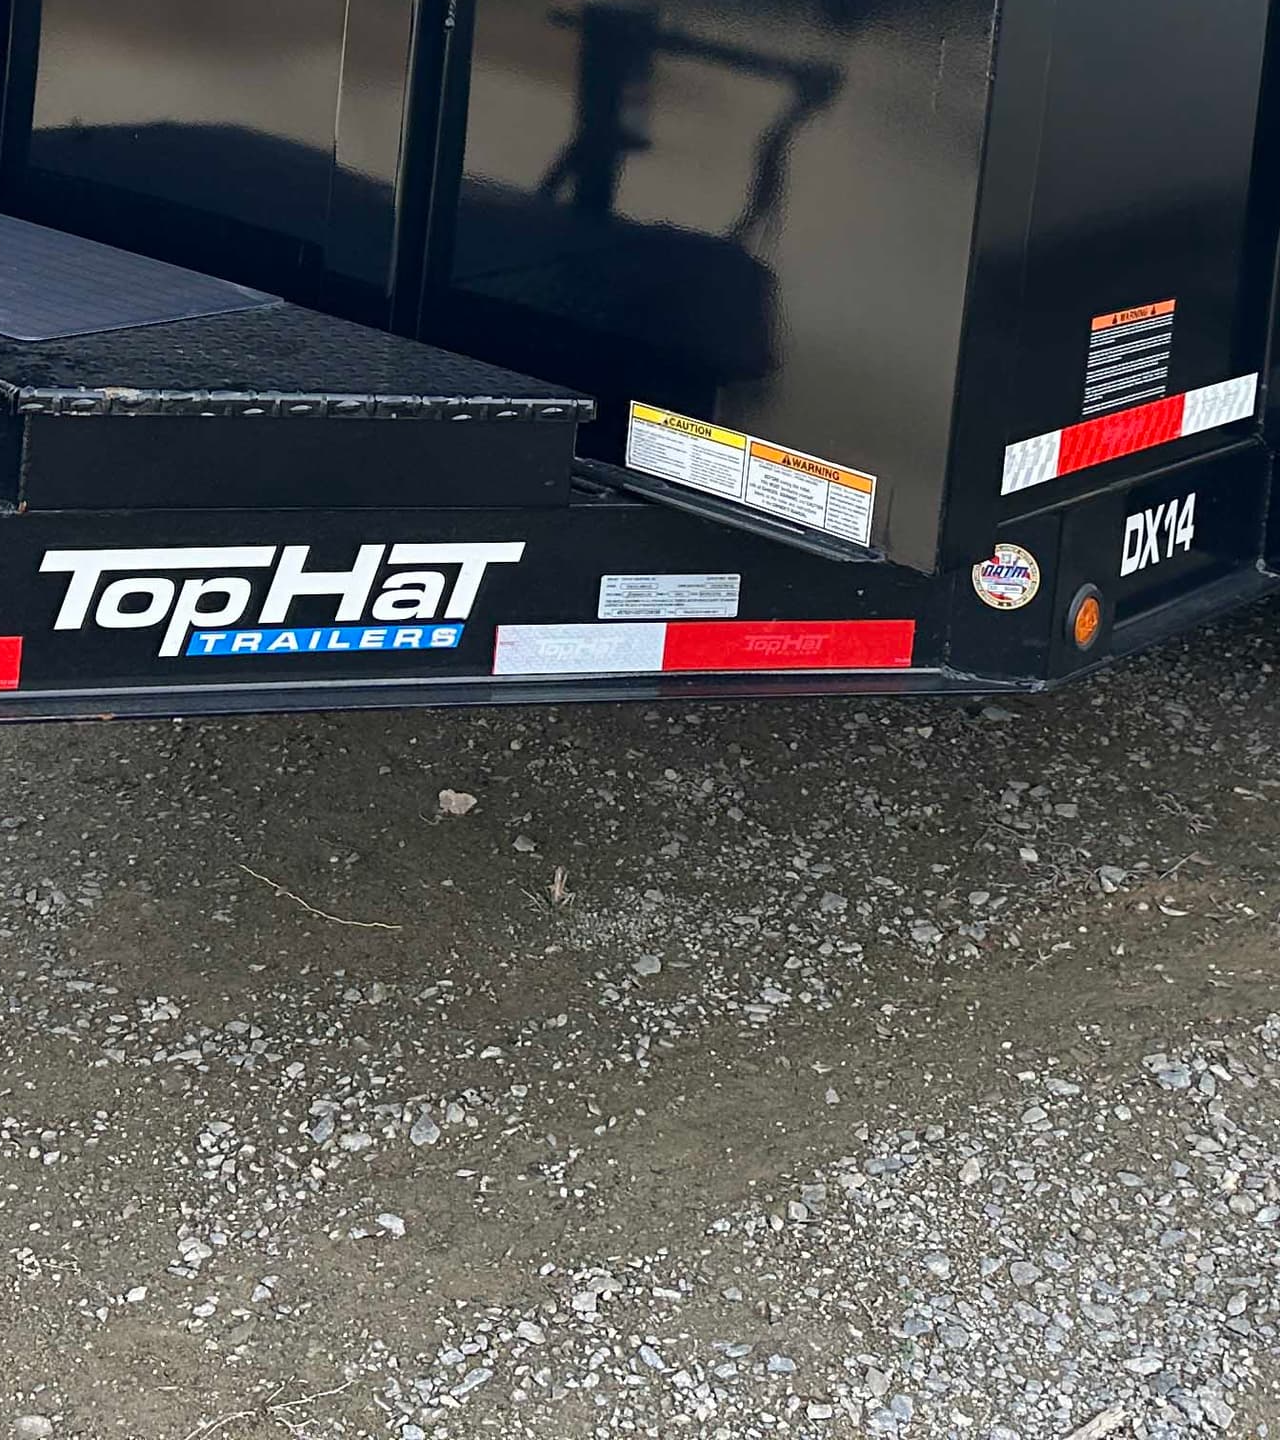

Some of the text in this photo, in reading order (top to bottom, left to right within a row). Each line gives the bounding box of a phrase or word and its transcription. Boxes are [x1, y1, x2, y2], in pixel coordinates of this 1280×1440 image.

[669, 417, 712, 438] CAUTION
[791, 457, 840, 481] WARNING
[1120, 492, 1196, 577] DX14
[198, 626, 459, 654] TRAILERS
